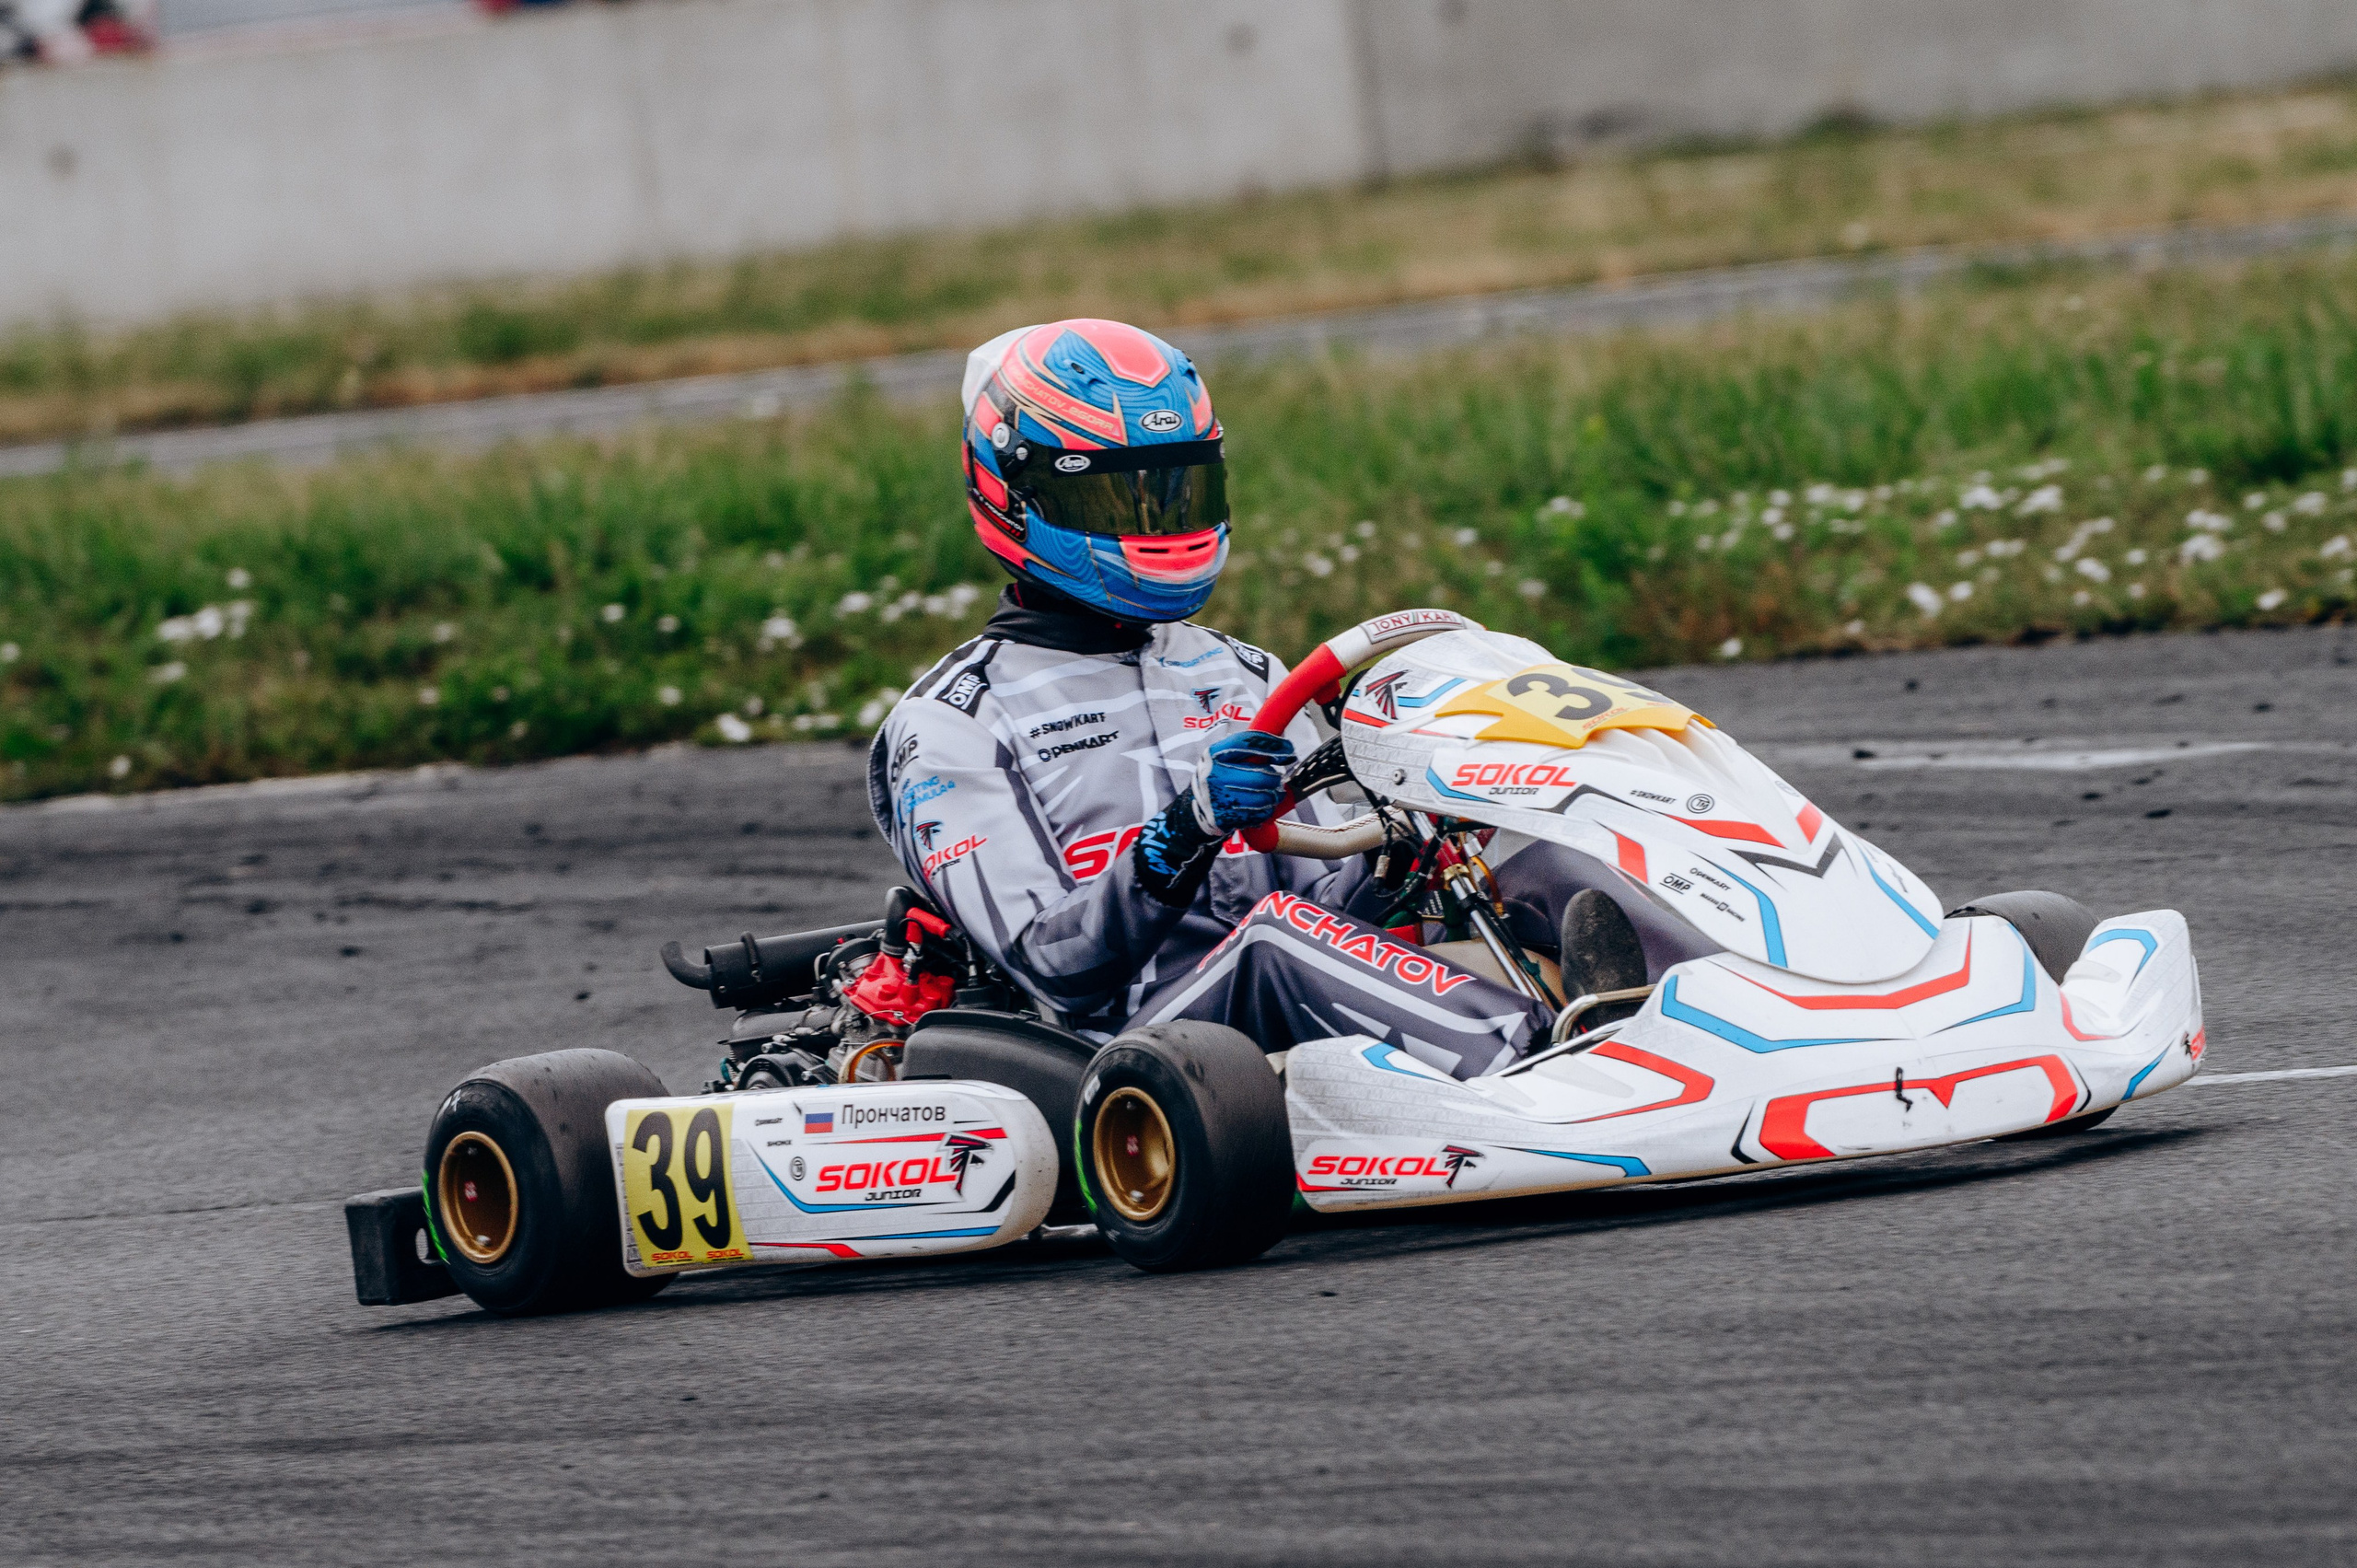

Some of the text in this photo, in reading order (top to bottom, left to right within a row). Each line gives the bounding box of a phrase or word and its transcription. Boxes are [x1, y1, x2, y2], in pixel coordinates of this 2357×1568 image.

[1148, 412, 1178, 425] Arai
[1060, 457, 1086, 469] Arai
[1367, 613, 1411, 632] TONY
[947, 673, 981, 706] OMP
[1038, 730, 1120, 763] OPENKART
[1451, 763, 1577, 787] SOKOL
[1489, 787, 1539, 796] JUNIOR
[923, 834, 987, 879] OKOL
[1663, 875, 1691, 891] OMP
[842, 1104, 946, 1129] Прончатов
[816, 1156, 958, 1192] SOKOL
[1306, 1156, 1451, 1177] SOKOL
[632, 1107, 732, 1251] 39
[1340, 1178, 1398, 1186] JUNIOR
[865, 1188, 923, 1202] JUNIOR
[651, 1250, 695, 1261] SOKOL
[706, 1249, 745, 1260] SOKOL
